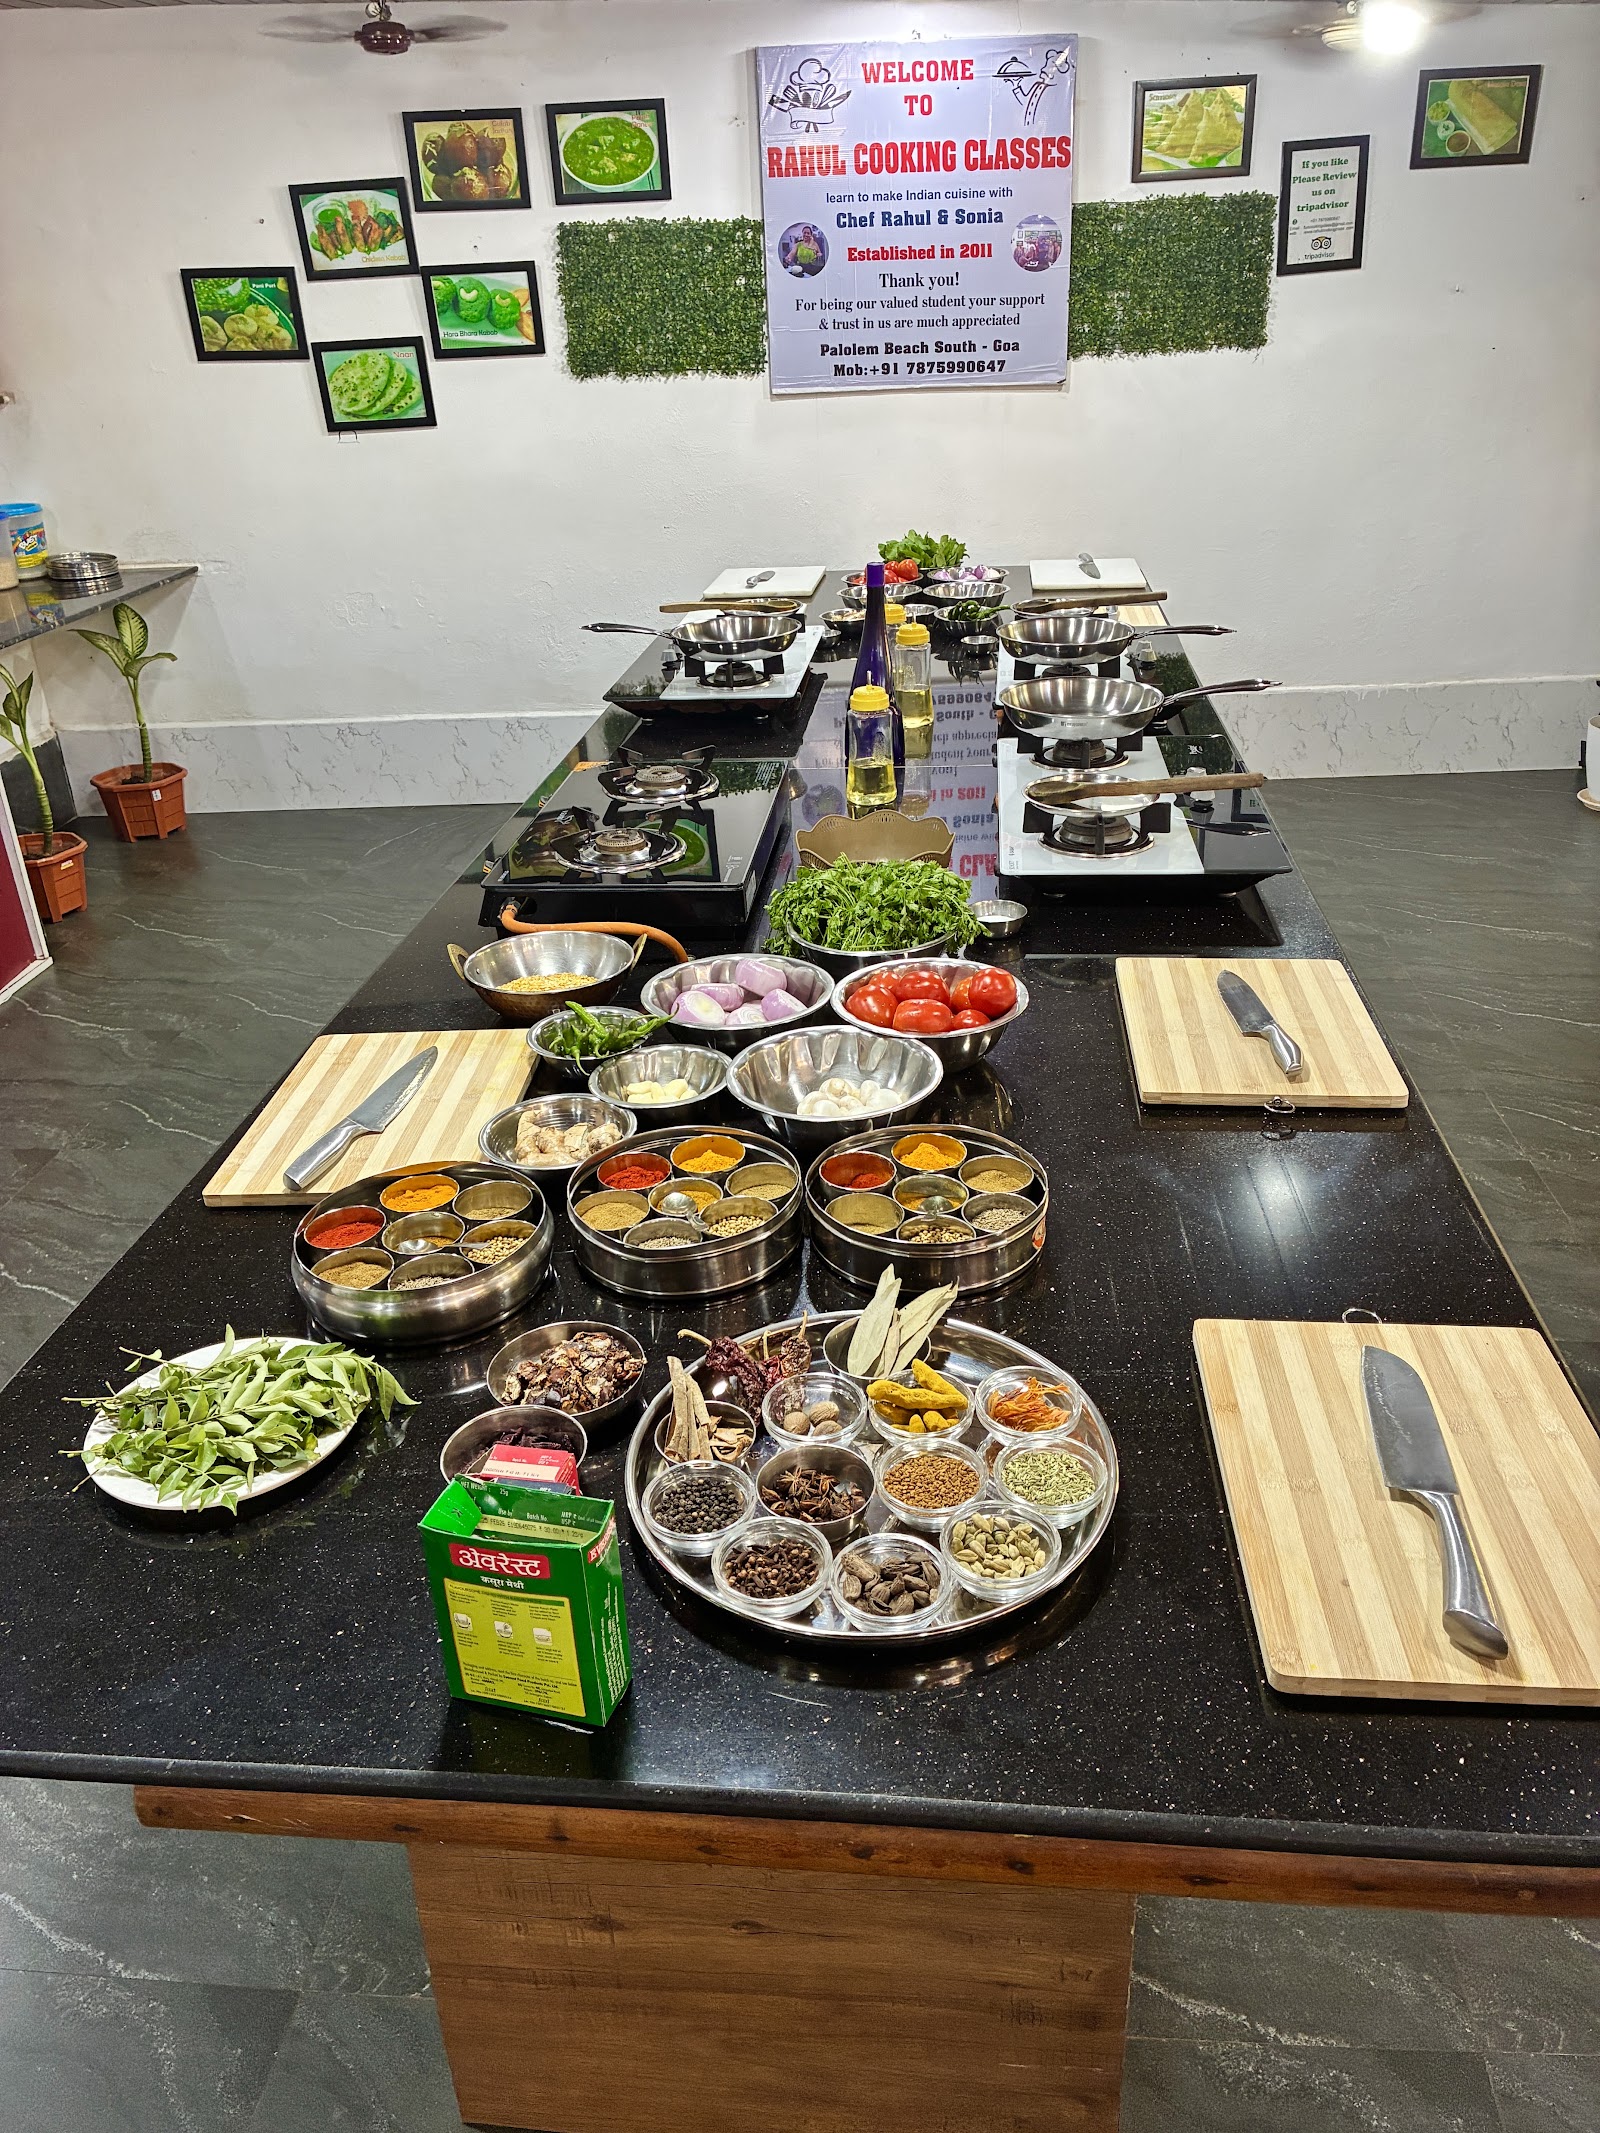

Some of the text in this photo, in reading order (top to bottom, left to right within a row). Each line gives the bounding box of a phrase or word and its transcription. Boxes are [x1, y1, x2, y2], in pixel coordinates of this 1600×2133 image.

[861, 59, 974, 84] WELCOME
[904, 94, 933, 116] TO
[767, 136, 1071, 178] RAHUL COOKING CLASSES
[1302, 158, 1349, 169] If you like
[1292, 172, 1357, 184] Please Review
[826, 186, 1013, 203] learn to make Indian cuisine with
[1311, 188, 1336, 197] us on
[1296, 200, 1350, 213] tripadvisor
[836, 207, 1004, 229] Chef Rahul & Sonia
[847, 243, 993, 262] Established in 2011
[1304, 252, 1335, 261] tripadvisor
[879, 271, 959, 290] Thank you!
[795, 293, 1045, 313] For being our valued student your support
[818, 313, 1020, 330] & trust in us are much appreciated
[820, 343, 879, 356] Palolem
[884, 341, 929, 355] Beach
[934, 340, 977, 353] South
[993, 339, 1020, 352] Goa
[833, 359, 1006, 377] Mob:+91 7875990647
[500, 1488, 509, 1496] 25g
[498, 1507, 507, 1516] Use
[526, 1512, 540, 1520] Batch
[561, 1511, 572, 1519] MRP
[505, 1578, 524, 1590] मेथी
